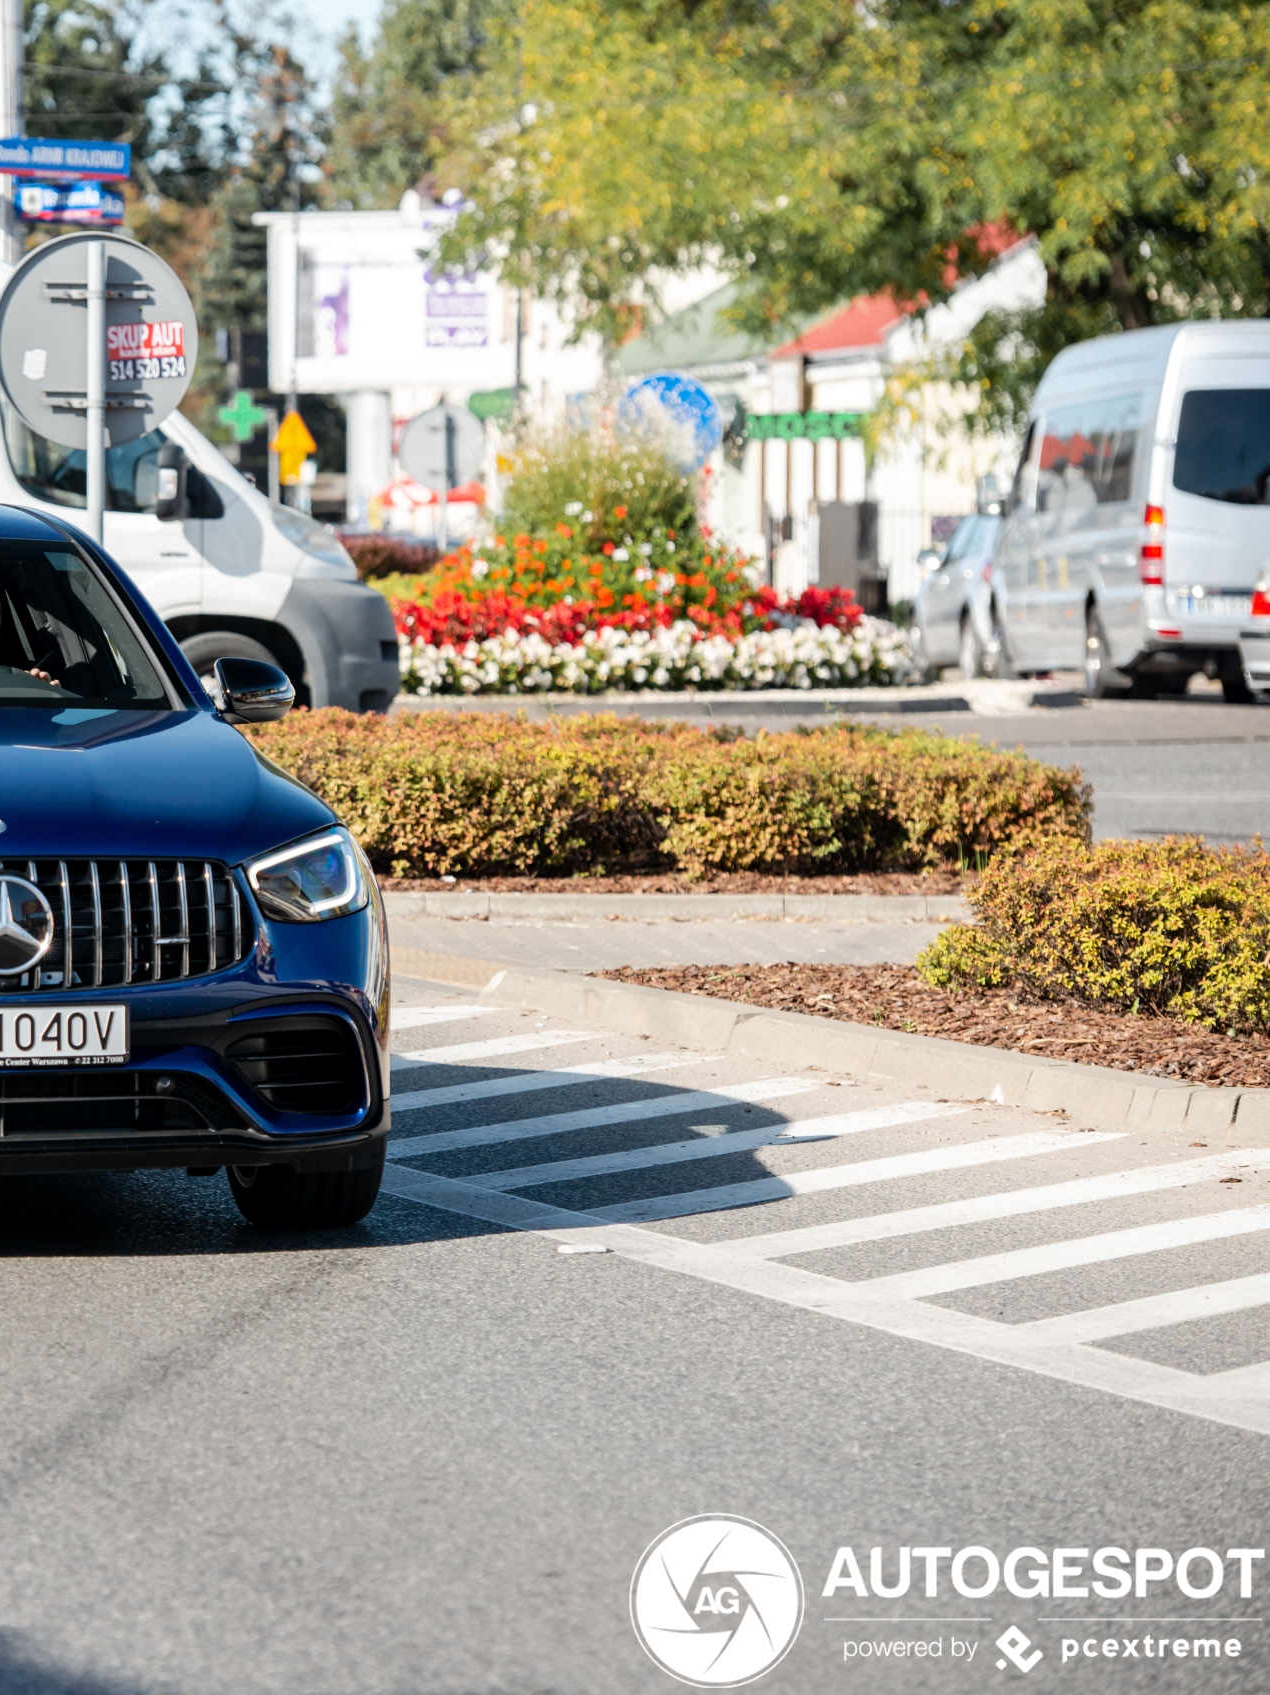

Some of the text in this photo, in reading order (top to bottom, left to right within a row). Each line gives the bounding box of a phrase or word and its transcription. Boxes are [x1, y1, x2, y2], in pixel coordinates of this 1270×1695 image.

[65, 148, 125, 169] KRAJOWEJ
[107, 322, 183, 349] SKUP AUT
[111, 356, 186, 380] 514 520 524
[6, 1058, 30, 1066] Center
[32, 1058, 68, 1066] Warszawa
[82, 1057, 91, 1065] 22
[92, 1056, 105, 1064] 312
[106, 1055, 124, 1063] 7000
